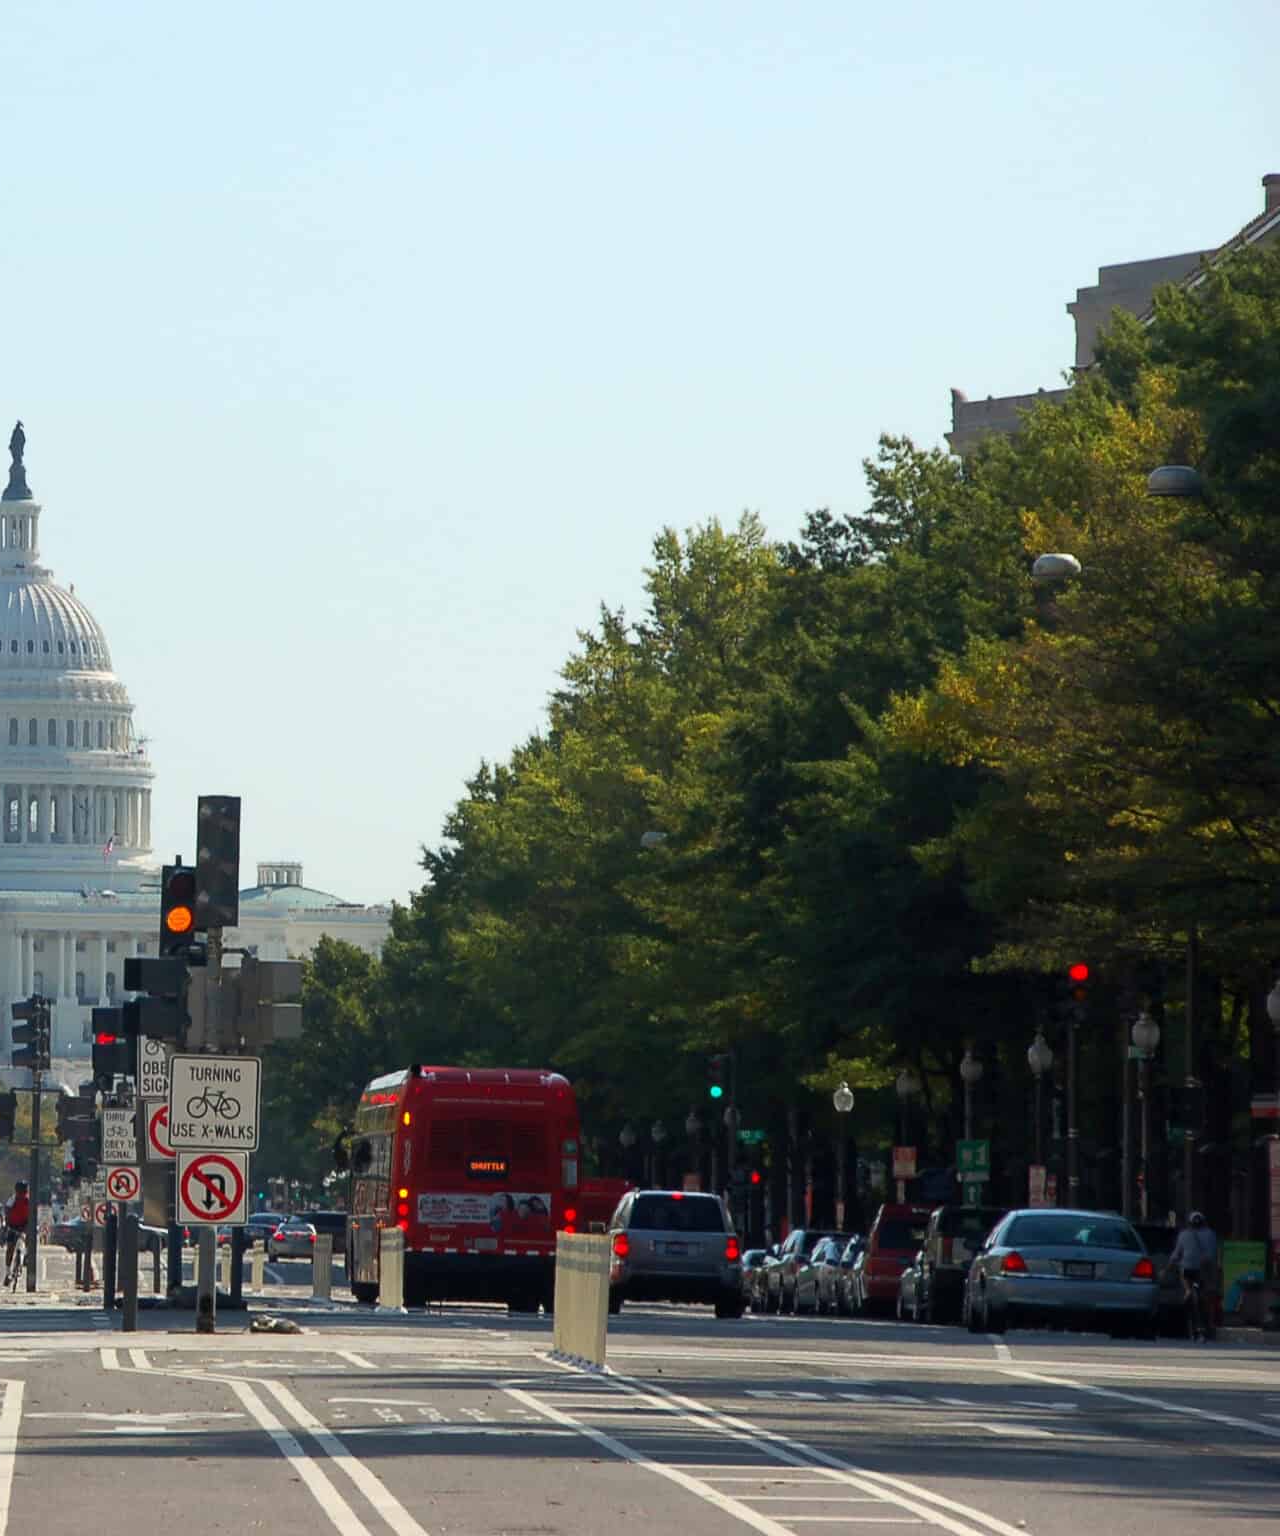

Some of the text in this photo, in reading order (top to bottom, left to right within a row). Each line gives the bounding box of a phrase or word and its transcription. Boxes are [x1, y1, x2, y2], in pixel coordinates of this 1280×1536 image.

[190, 1066, 241, 1082] TURNING
[172, 1123, 254, 1140] USE X-WALKS
[470, 1162, 505, 1171] SHUTTLE
